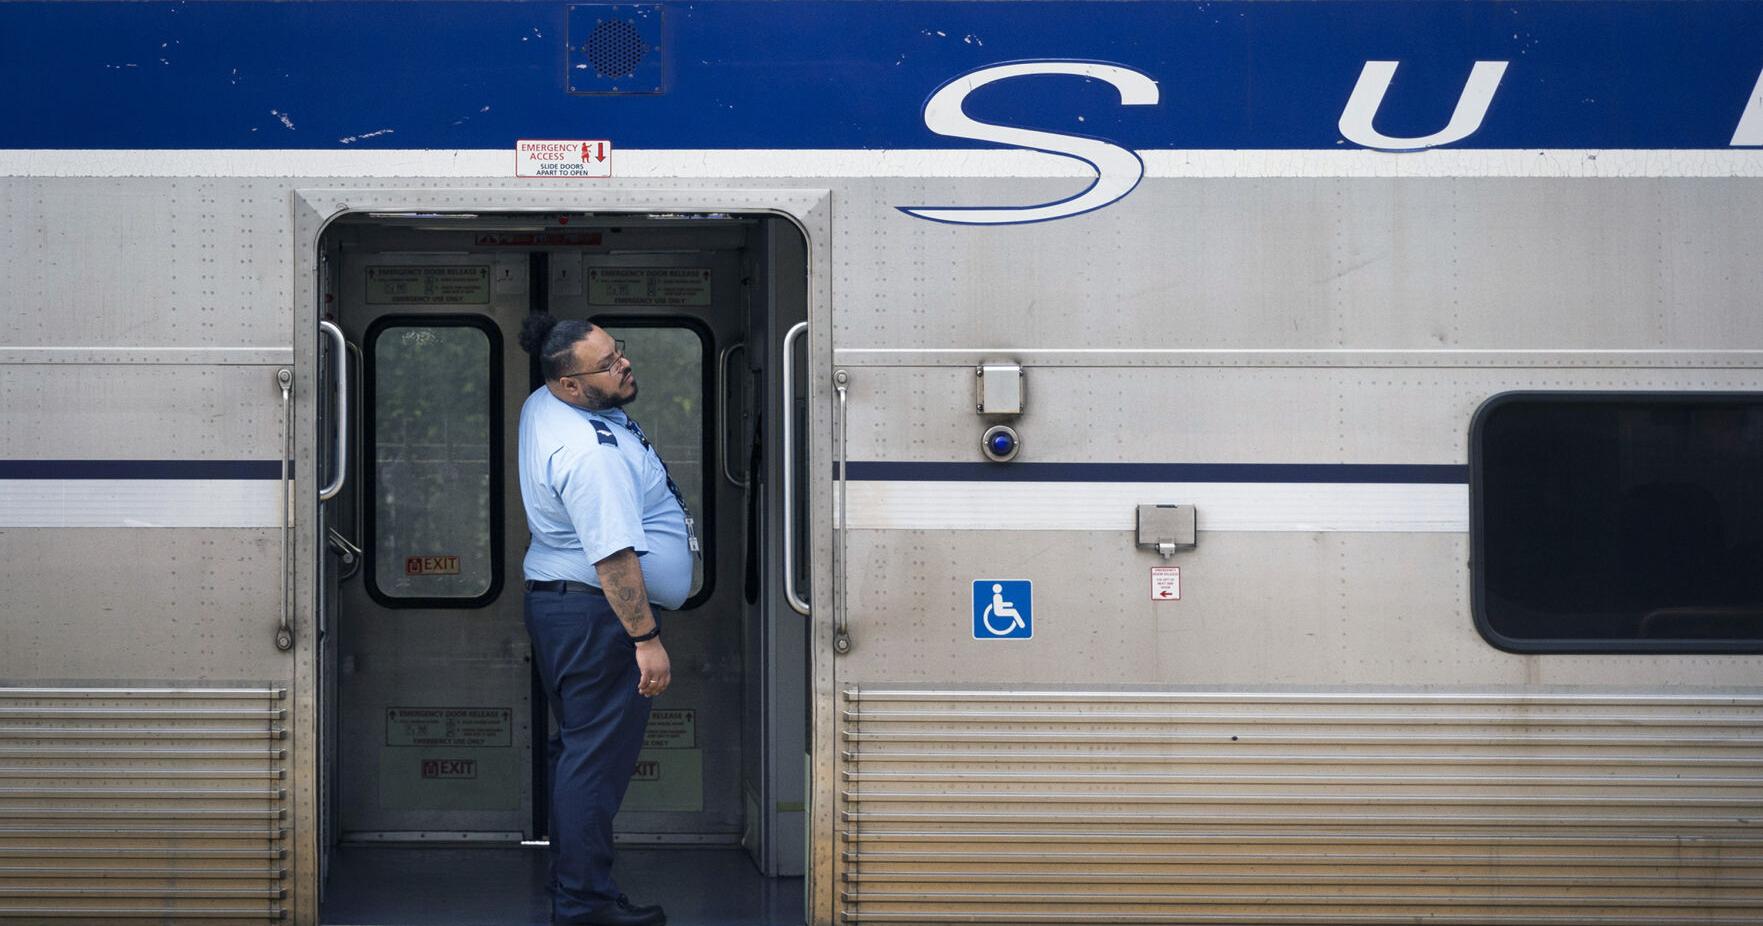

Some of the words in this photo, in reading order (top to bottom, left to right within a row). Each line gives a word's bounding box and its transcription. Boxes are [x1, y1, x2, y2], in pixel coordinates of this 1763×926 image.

[521, 143, 578, 152] EMERGENCY
[529, 152, 565, 161] ACCESS
[424, 557, 457, 570] EXIT
[440, 761, 473, 774] EXIT
[633, 761, 656, 776] XIT
